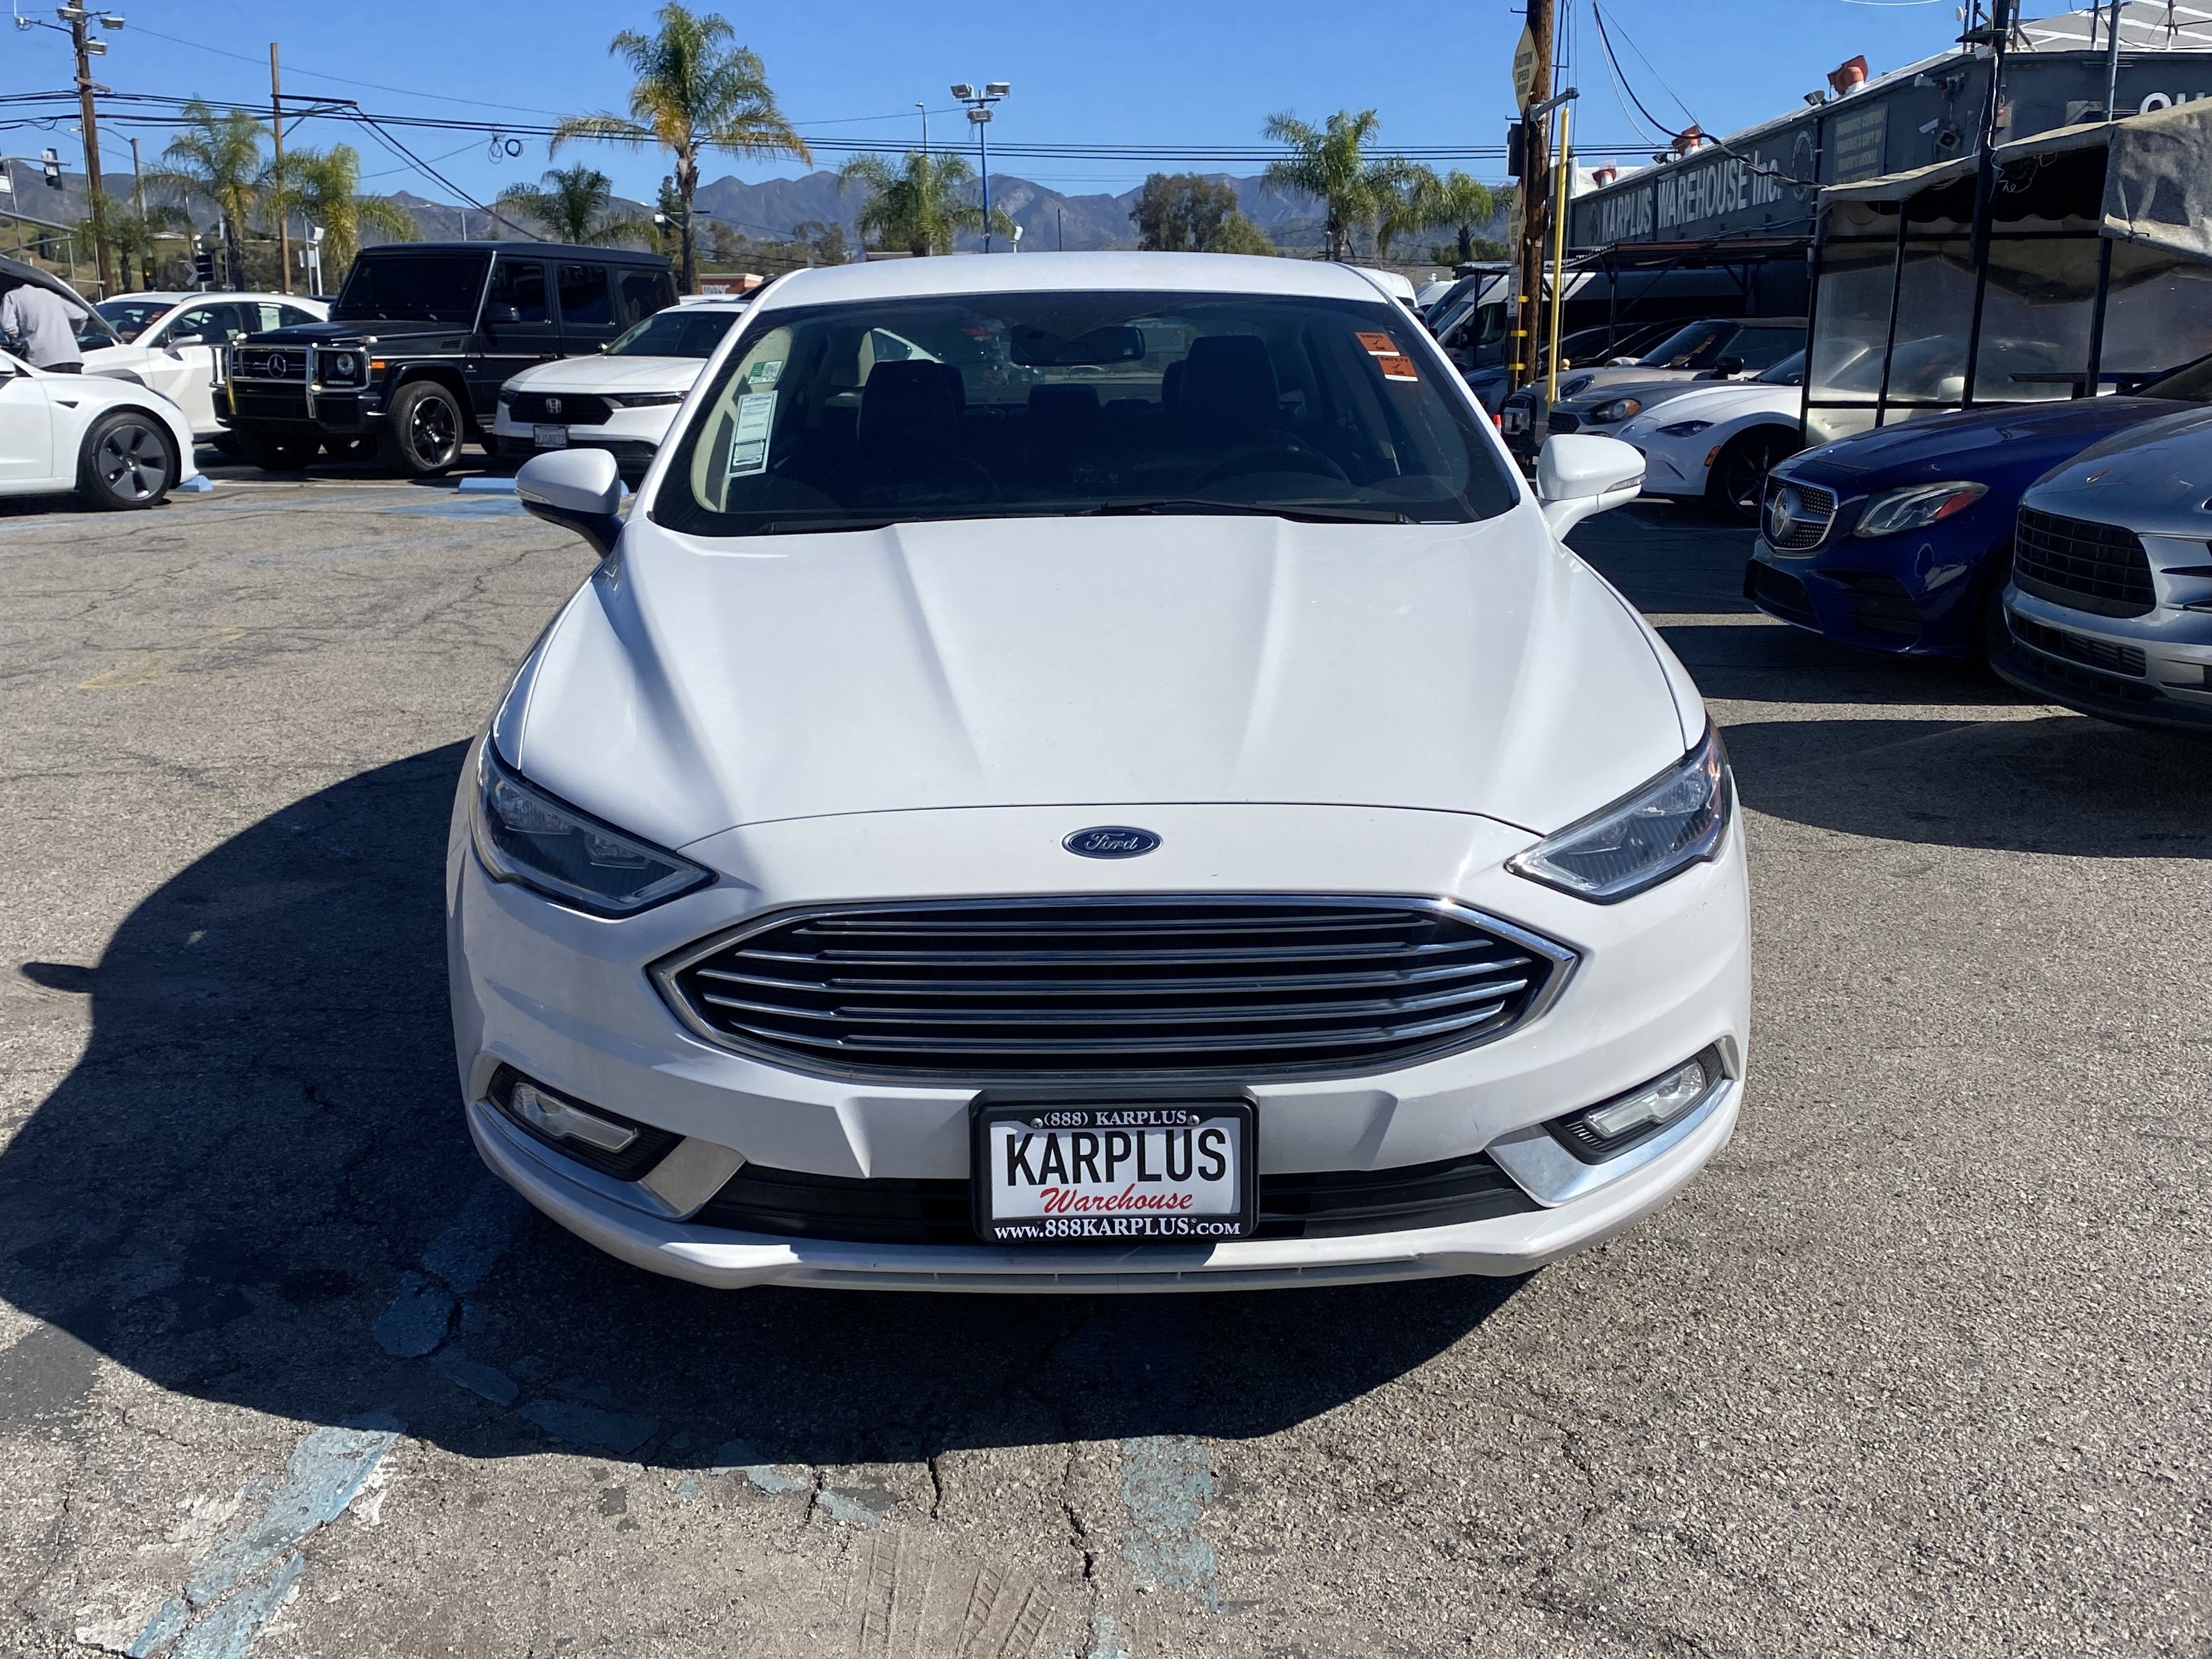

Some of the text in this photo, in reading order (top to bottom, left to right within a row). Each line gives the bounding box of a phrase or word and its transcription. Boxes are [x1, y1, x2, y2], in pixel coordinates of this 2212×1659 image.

[1517, 69, 1530, 83] SPEED
[1602, 187, 1652, 243] KARPLUS
[1657, 153, 1751, 229] WAREHOUSE
[1753, 149, 1784, 206] Inc.
[1510, 293, 1516, 308] 5
[1084, 832, 1138, 850] Ford
[1043, 1110, 1187, 1126] (888) KARPLUS
[1006, 1128, 1226, 1186] KARPLUS
[1040, 1183, 1194, 1214] Warehouse
